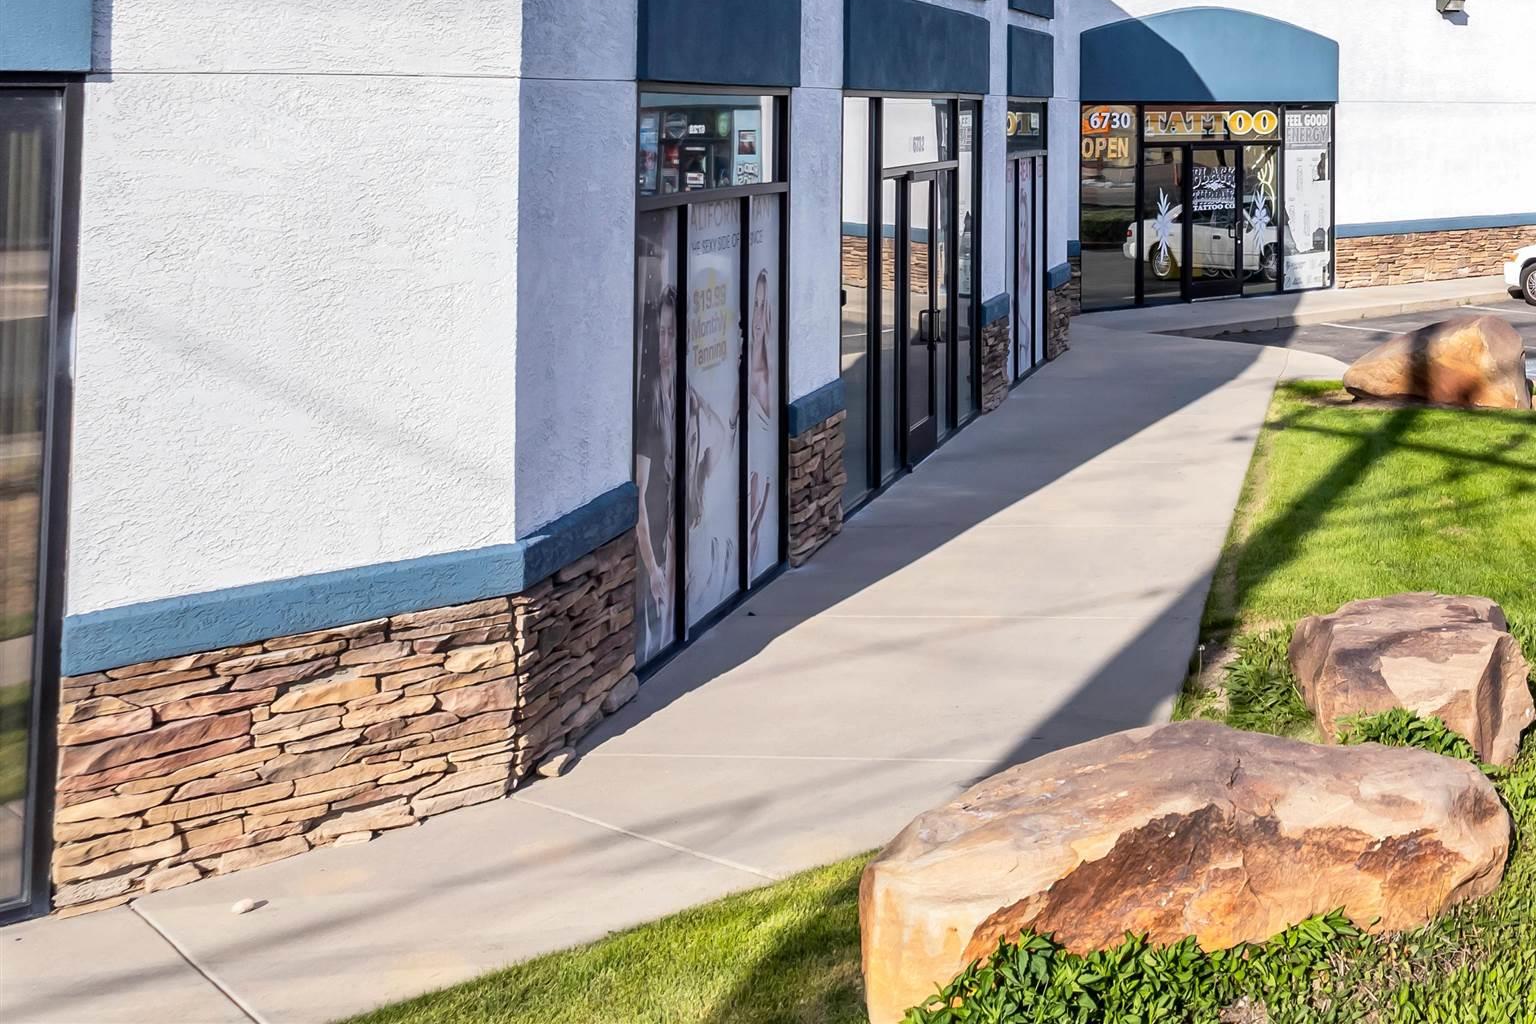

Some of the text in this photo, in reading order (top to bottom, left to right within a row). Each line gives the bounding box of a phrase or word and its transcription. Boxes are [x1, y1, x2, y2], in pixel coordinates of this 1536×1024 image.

[1090, 112, 1131, 129] 6730
[1144, 110, 1278, 136] TATTOO
[1286, 113, 1328, 127] FEEL GOOD
[1287, 127, 1328, 143] ENERGY
[1082, 137, 1129, 158] OPEN
[692, 341, 727, 368] Tanning
